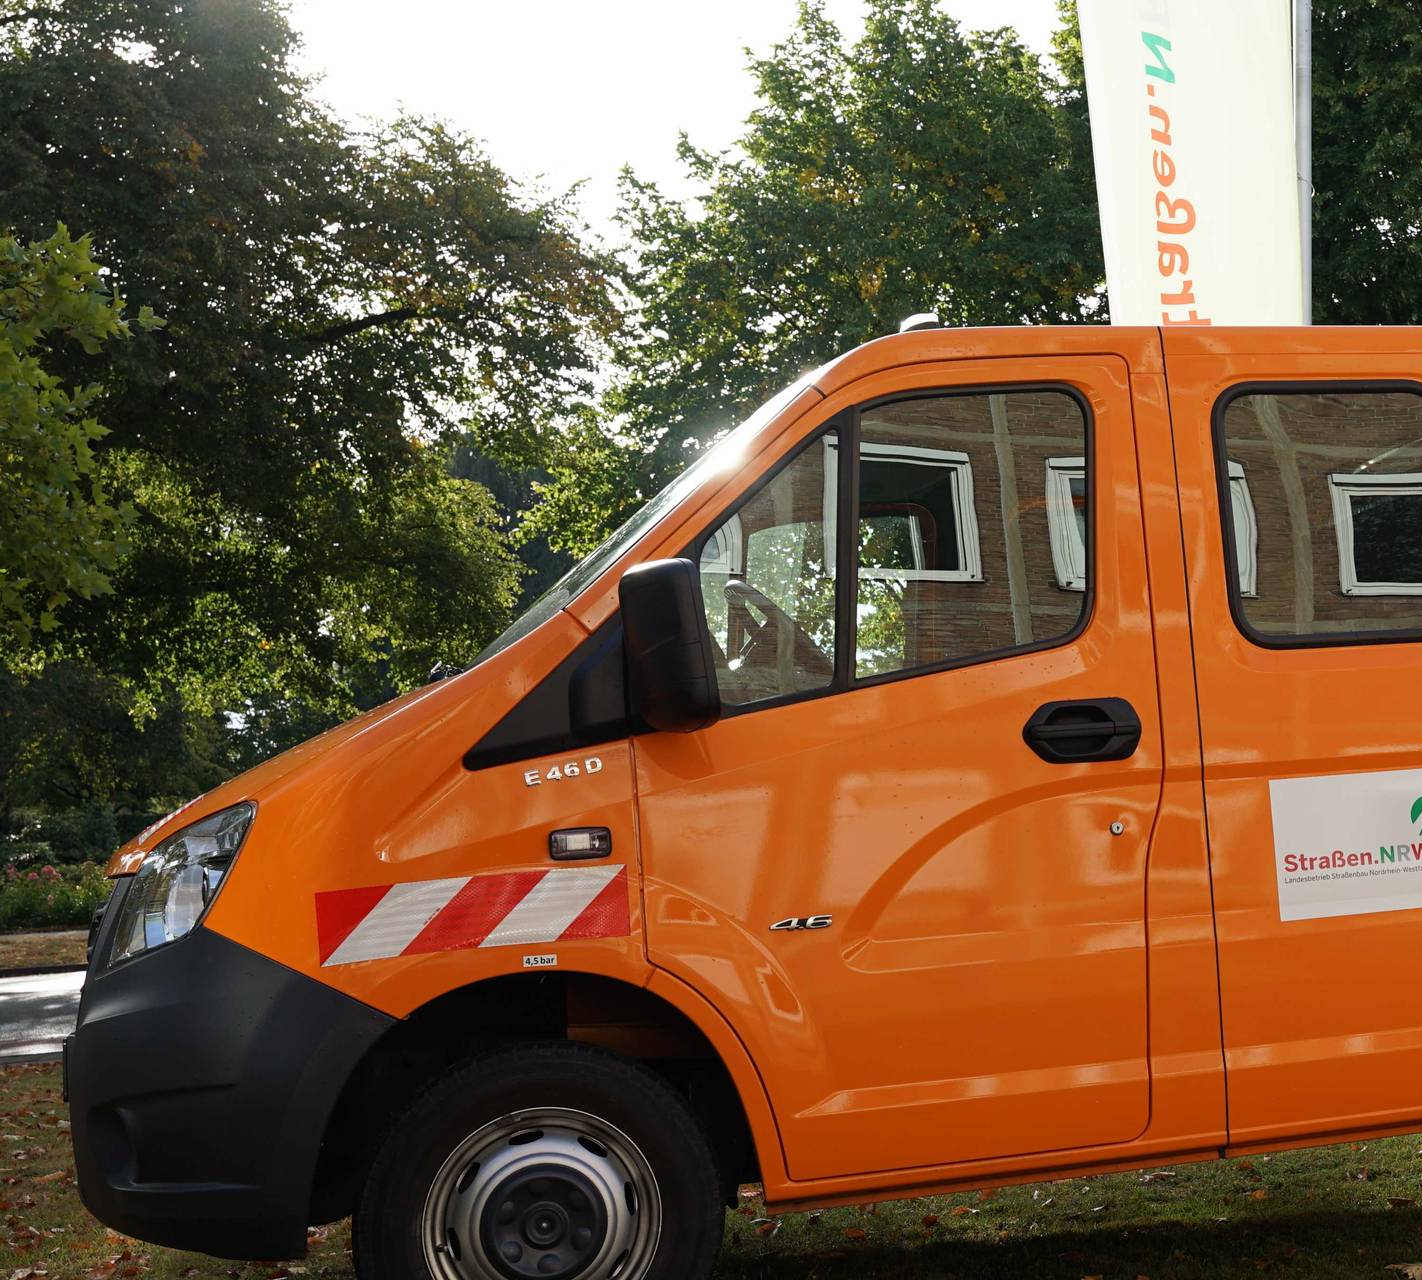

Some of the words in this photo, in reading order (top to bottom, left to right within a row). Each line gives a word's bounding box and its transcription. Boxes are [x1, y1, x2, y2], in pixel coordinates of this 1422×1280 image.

[1284, 873, 1331, 884] Landesbetrieb
[1331, 870, 1369, 880] Straßenbau
[525, 957, 539, 966] 4,5
[540, 956, 555, 965] bar
